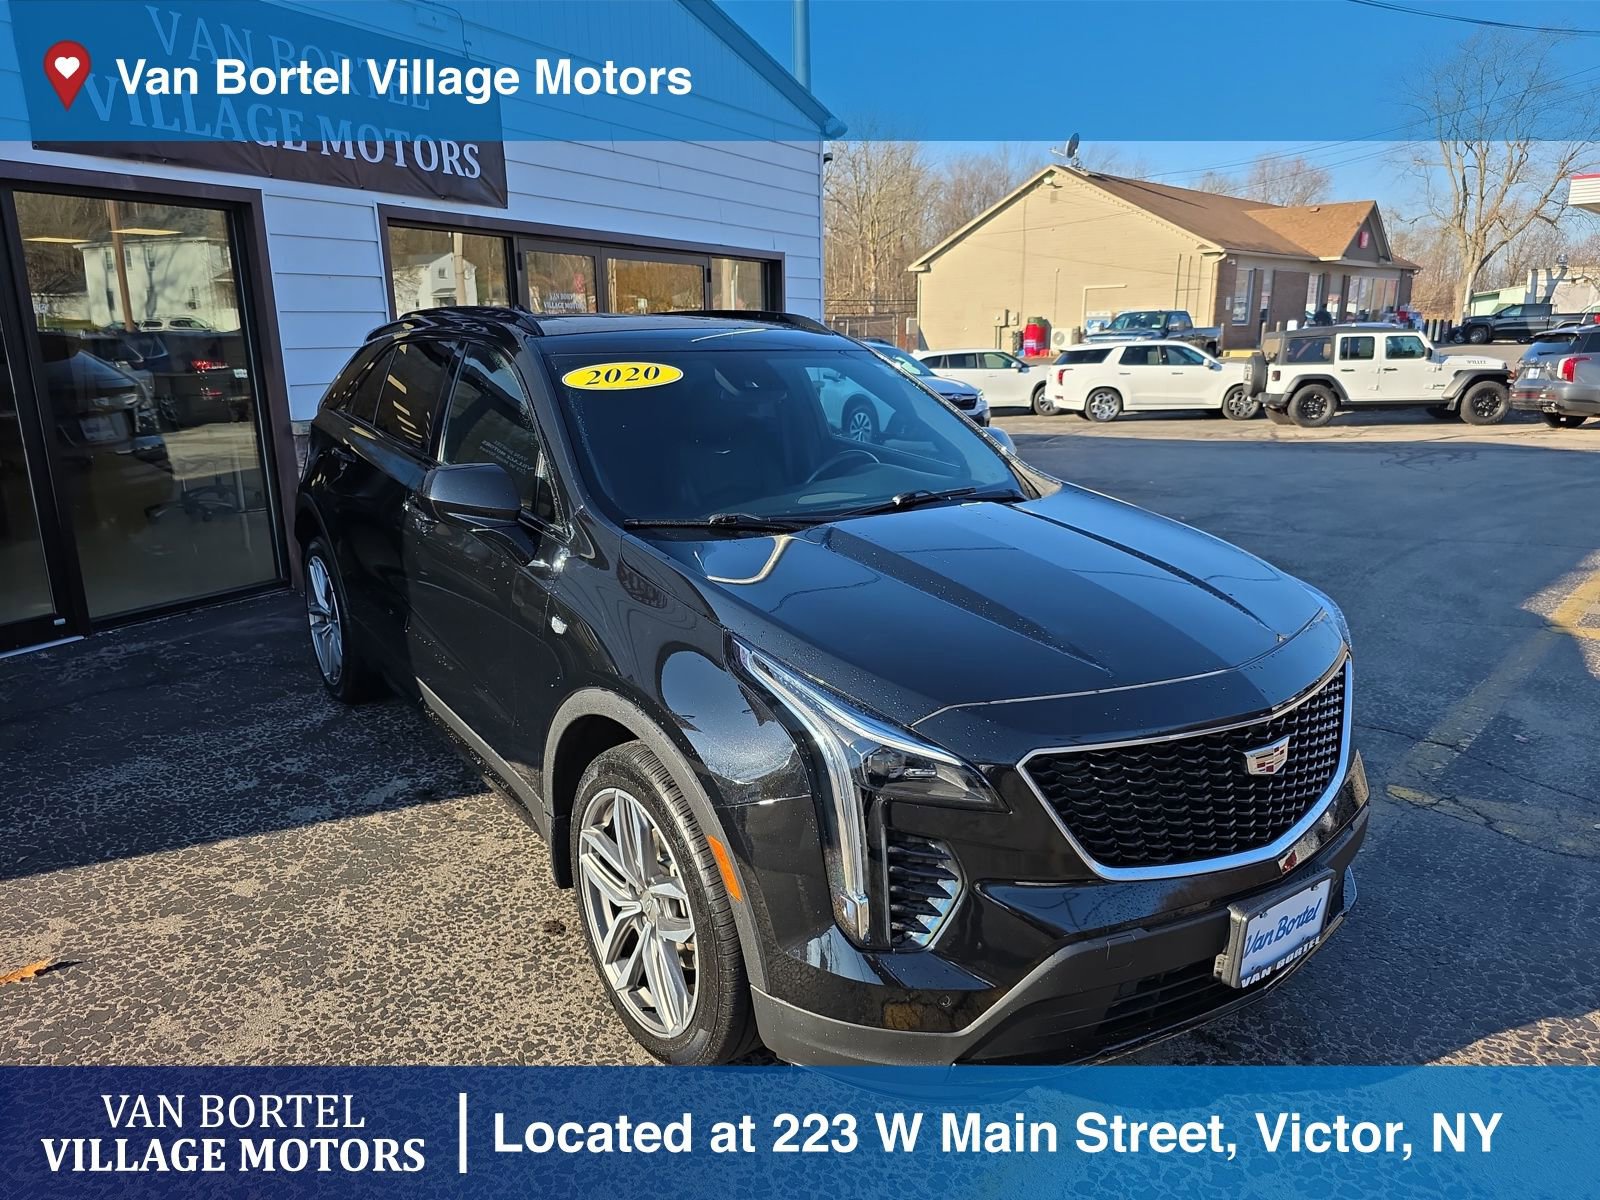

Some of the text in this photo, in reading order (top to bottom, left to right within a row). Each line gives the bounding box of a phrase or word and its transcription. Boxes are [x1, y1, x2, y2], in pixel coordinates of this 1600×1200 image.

[145, 4, 430, 111] VAN BORTEL
[86, 72, 482, 178] VILLAGE MOTORS
[585, 366, 661, 386] 2020
[1244, 898, 1322, 959] Van Bortel
[1240, 936, 1321, 989] VAN BORTEL
